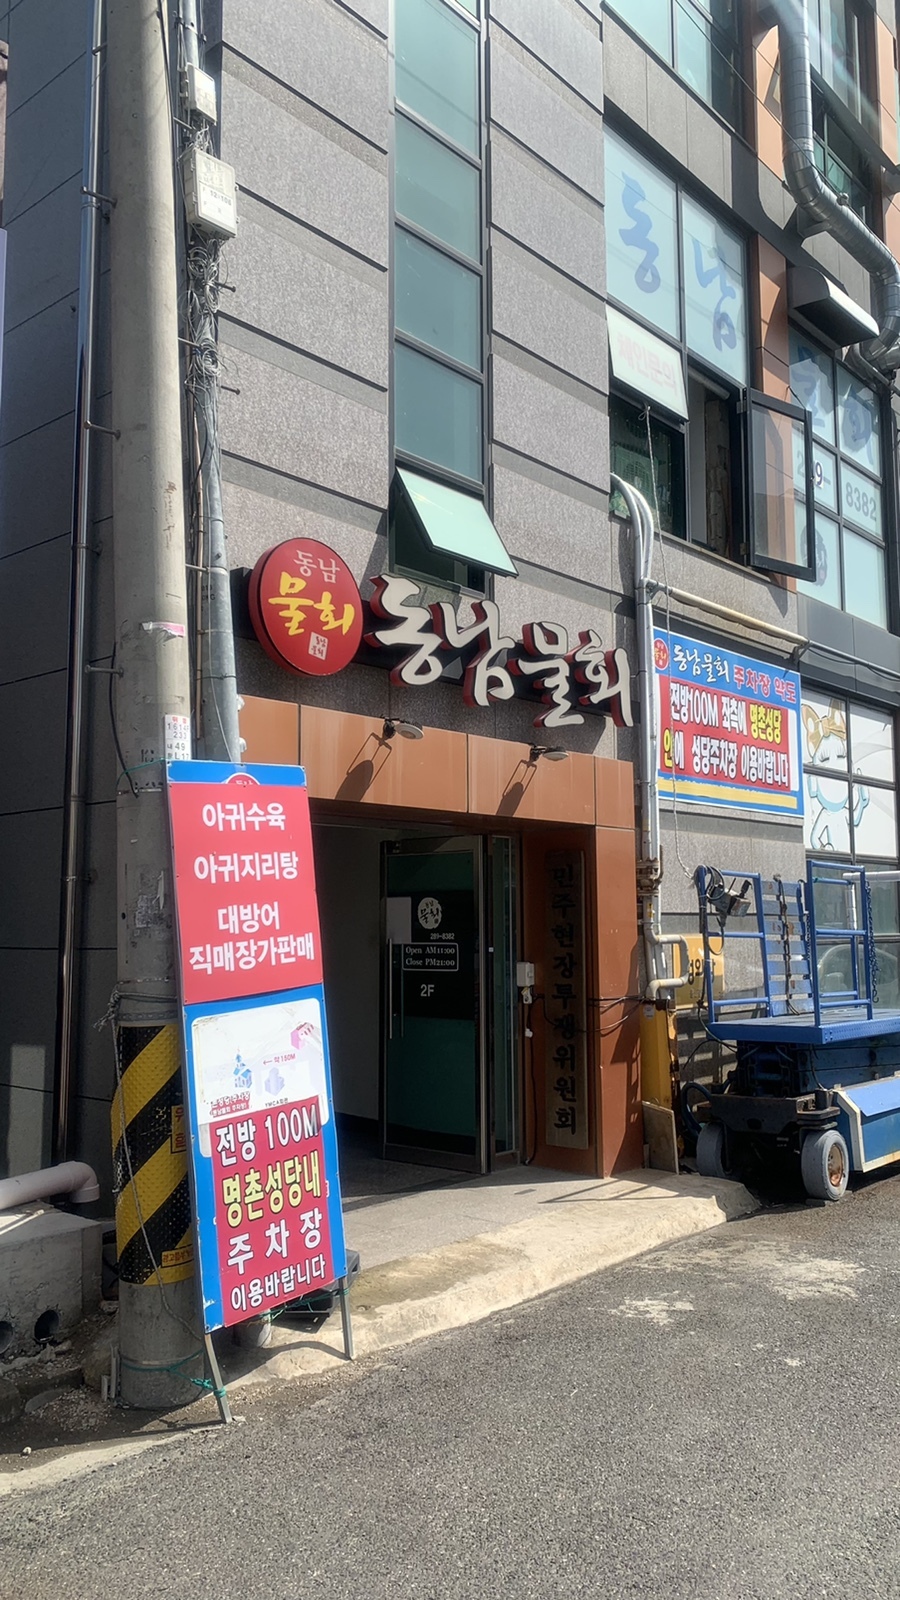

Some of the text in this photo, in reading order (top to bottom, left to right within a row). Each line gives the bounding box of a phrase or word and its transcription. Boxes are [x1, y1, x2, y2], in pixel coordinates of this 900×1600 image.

[293, 549, 341, 584] 동남
[268, 571, 356, 636] 물회
[366, 574, 633, 728] 동남물회
[673, 644, 731, 683] 동남물회
[733, 664, 771, 698] 주차장
[774, 676, 797, 703] 약도
[721, 695, 748, 736] 좌측에
[749, 703, 782, 745] 명촌성당
[691, 735, 738, 780] 성당주차장
[740, 744, 789, 788] 이용바랍니다
[202, 802, 286, 831] 아귀수육
[193, 851, 299, 884] 아귀지리탕
[217, 901, 281, 935] 대방어
[189, 932, 315, 975] 직매장가판매
[405, 946, 423, 955] Open
[405, 957, 456, 966] Close PM21:00
[420, 984, 435, 997] 2F
[215, 1105, 320, 1167] 전방 100M
[222, 1149, 321, 1228] 명촌성당내
[227, 1206, 322, 1276] 주차장
[231, 1254, 326, 1312] 이용바랍니다
